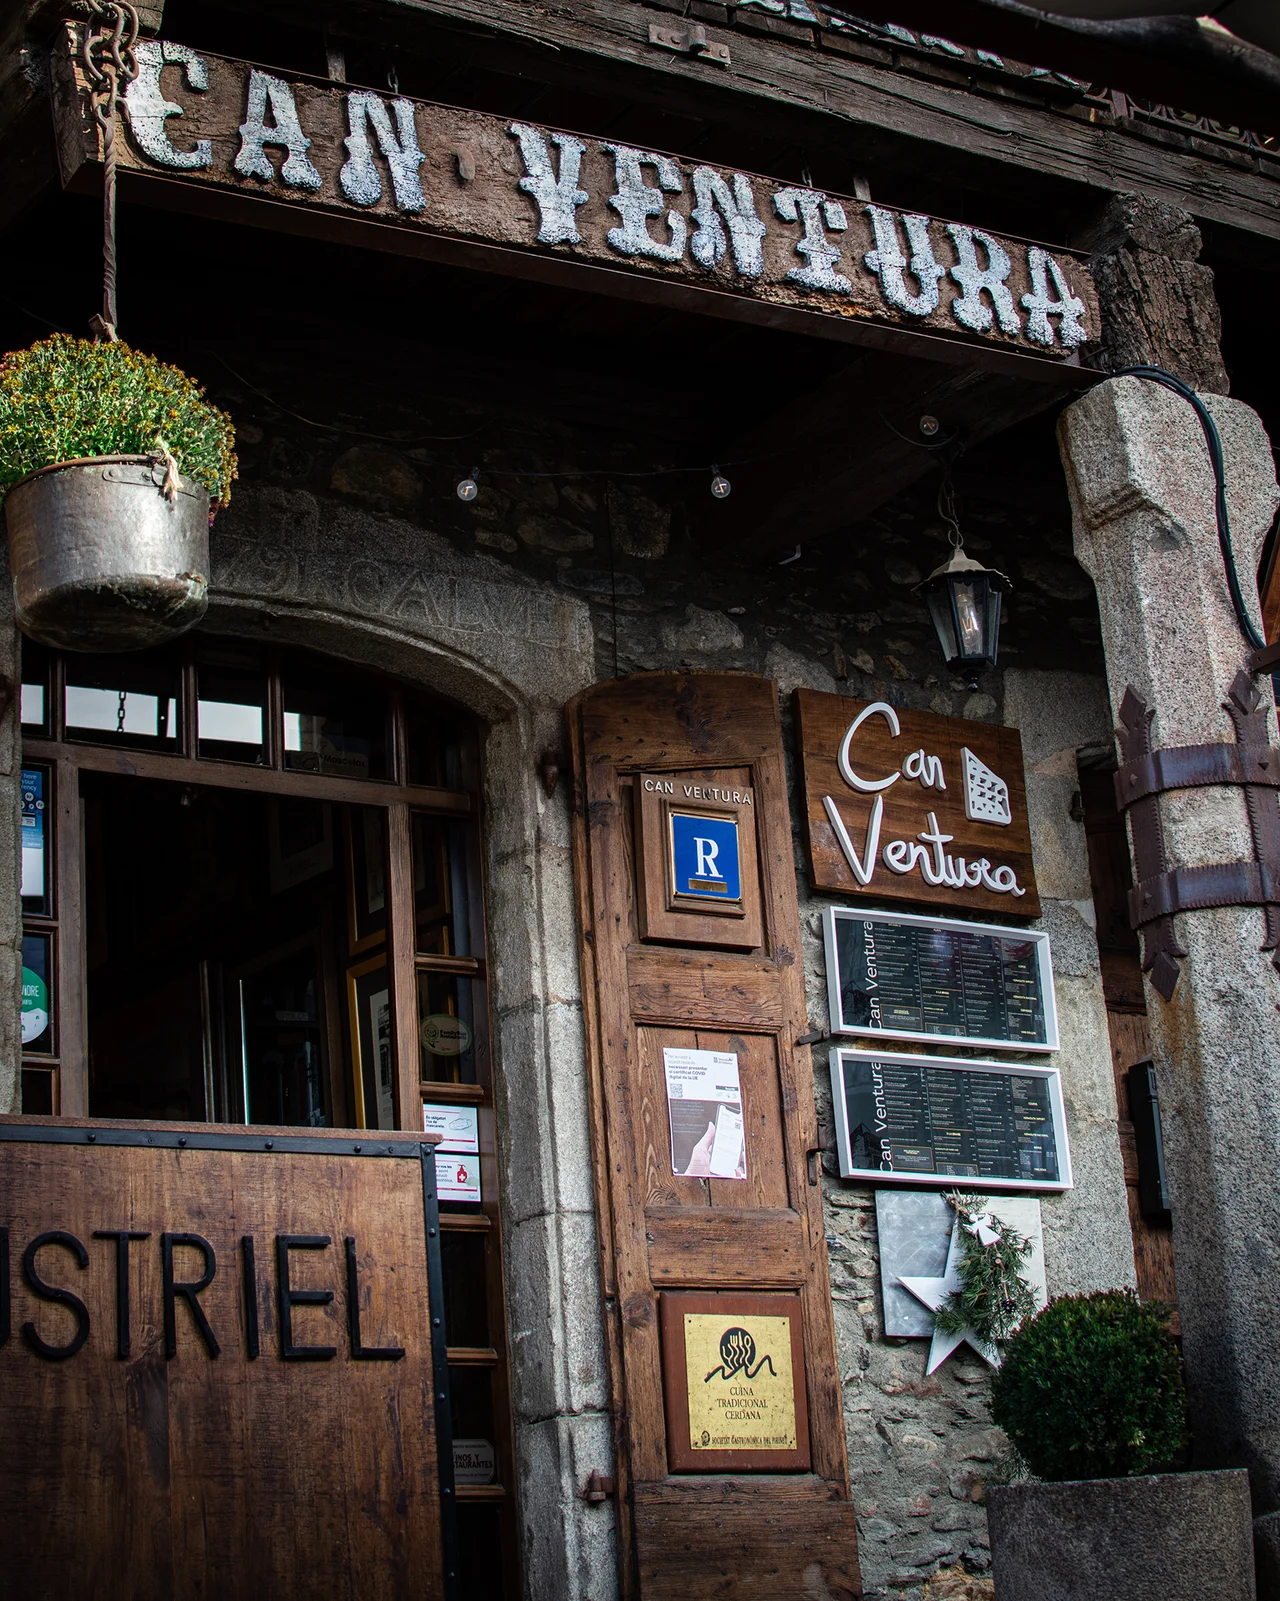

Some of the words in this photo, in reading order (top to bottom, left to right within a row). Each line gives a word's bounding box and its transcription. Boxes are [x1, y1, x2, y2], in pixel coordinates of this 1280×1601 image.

[122, 40, 427, 214] CAN
[508, 121, 1088, 350] VENTURA
[838, 701, 947, 793] Can
[644, 779, 674, 794] CAN
[683, 785, 752, 805] VENTURA
[693, 837, 724, 878] R
[822, 794, 1026, 898] Ventura
[863, 920, 879, 992] Ventura
[870, 1062, 888, 1133] Ventura
[879, 1138, 893, 1173] Can
[0, 1226, 405, 1362] STRIEL
[717, 1398, 768, 1408] TRADICIONAL
[725, 1411, 761, 1420] CERDANA
[729, 1386, 755, 1397] CUINA
